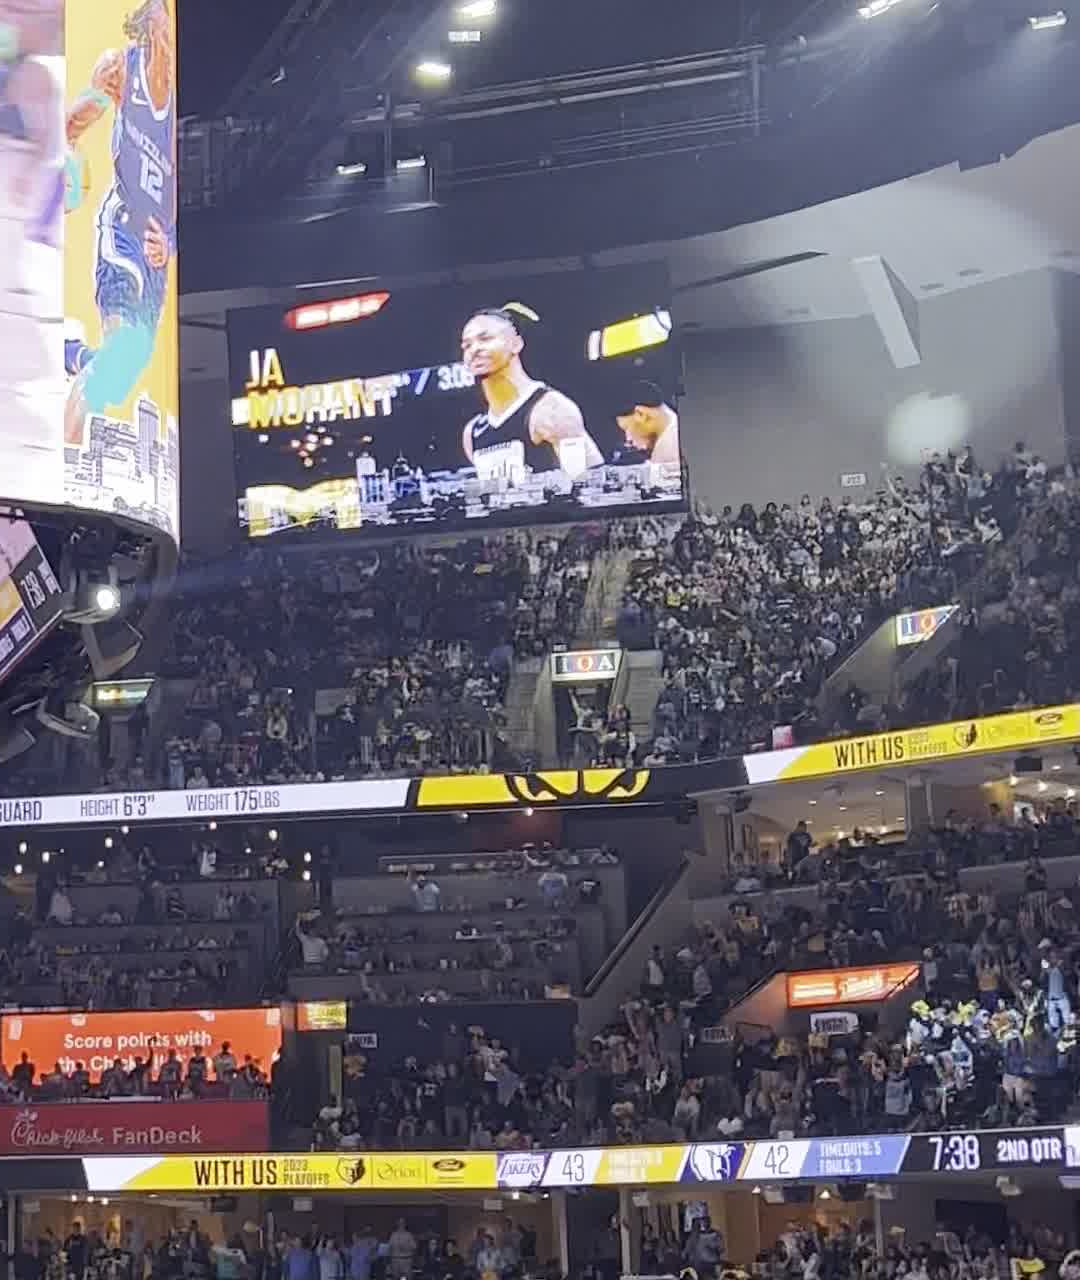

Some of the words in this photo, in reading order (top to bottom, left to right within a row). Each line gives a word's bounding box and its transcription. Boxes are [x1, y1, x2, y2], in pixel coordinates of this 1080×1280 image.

[246, 347, 285, 388] JA
[835, 741, 877, 767] WITH
[883, 735, 904, 761] US
[80, 798, 120, 817] HEIGHT
[186, 793, 231, 812] WEIGHT
[63, 1032, 113, 1049] Score
[175, 1029, 212, 1048] with
[112, 1124, 203, 1146] FanDeck
[764, 1144, 790, 1175] 42
[928, 1134, 980, 1171] 7:38
[997, 1138, 1028, 1162] 2ND
[1031, 1136, 1062, 1162] QTR
[195, 1159, 245, 1186] WITH
[252, 1159, 277, 1186] US
[562, 1153, 585, 1182] 43
